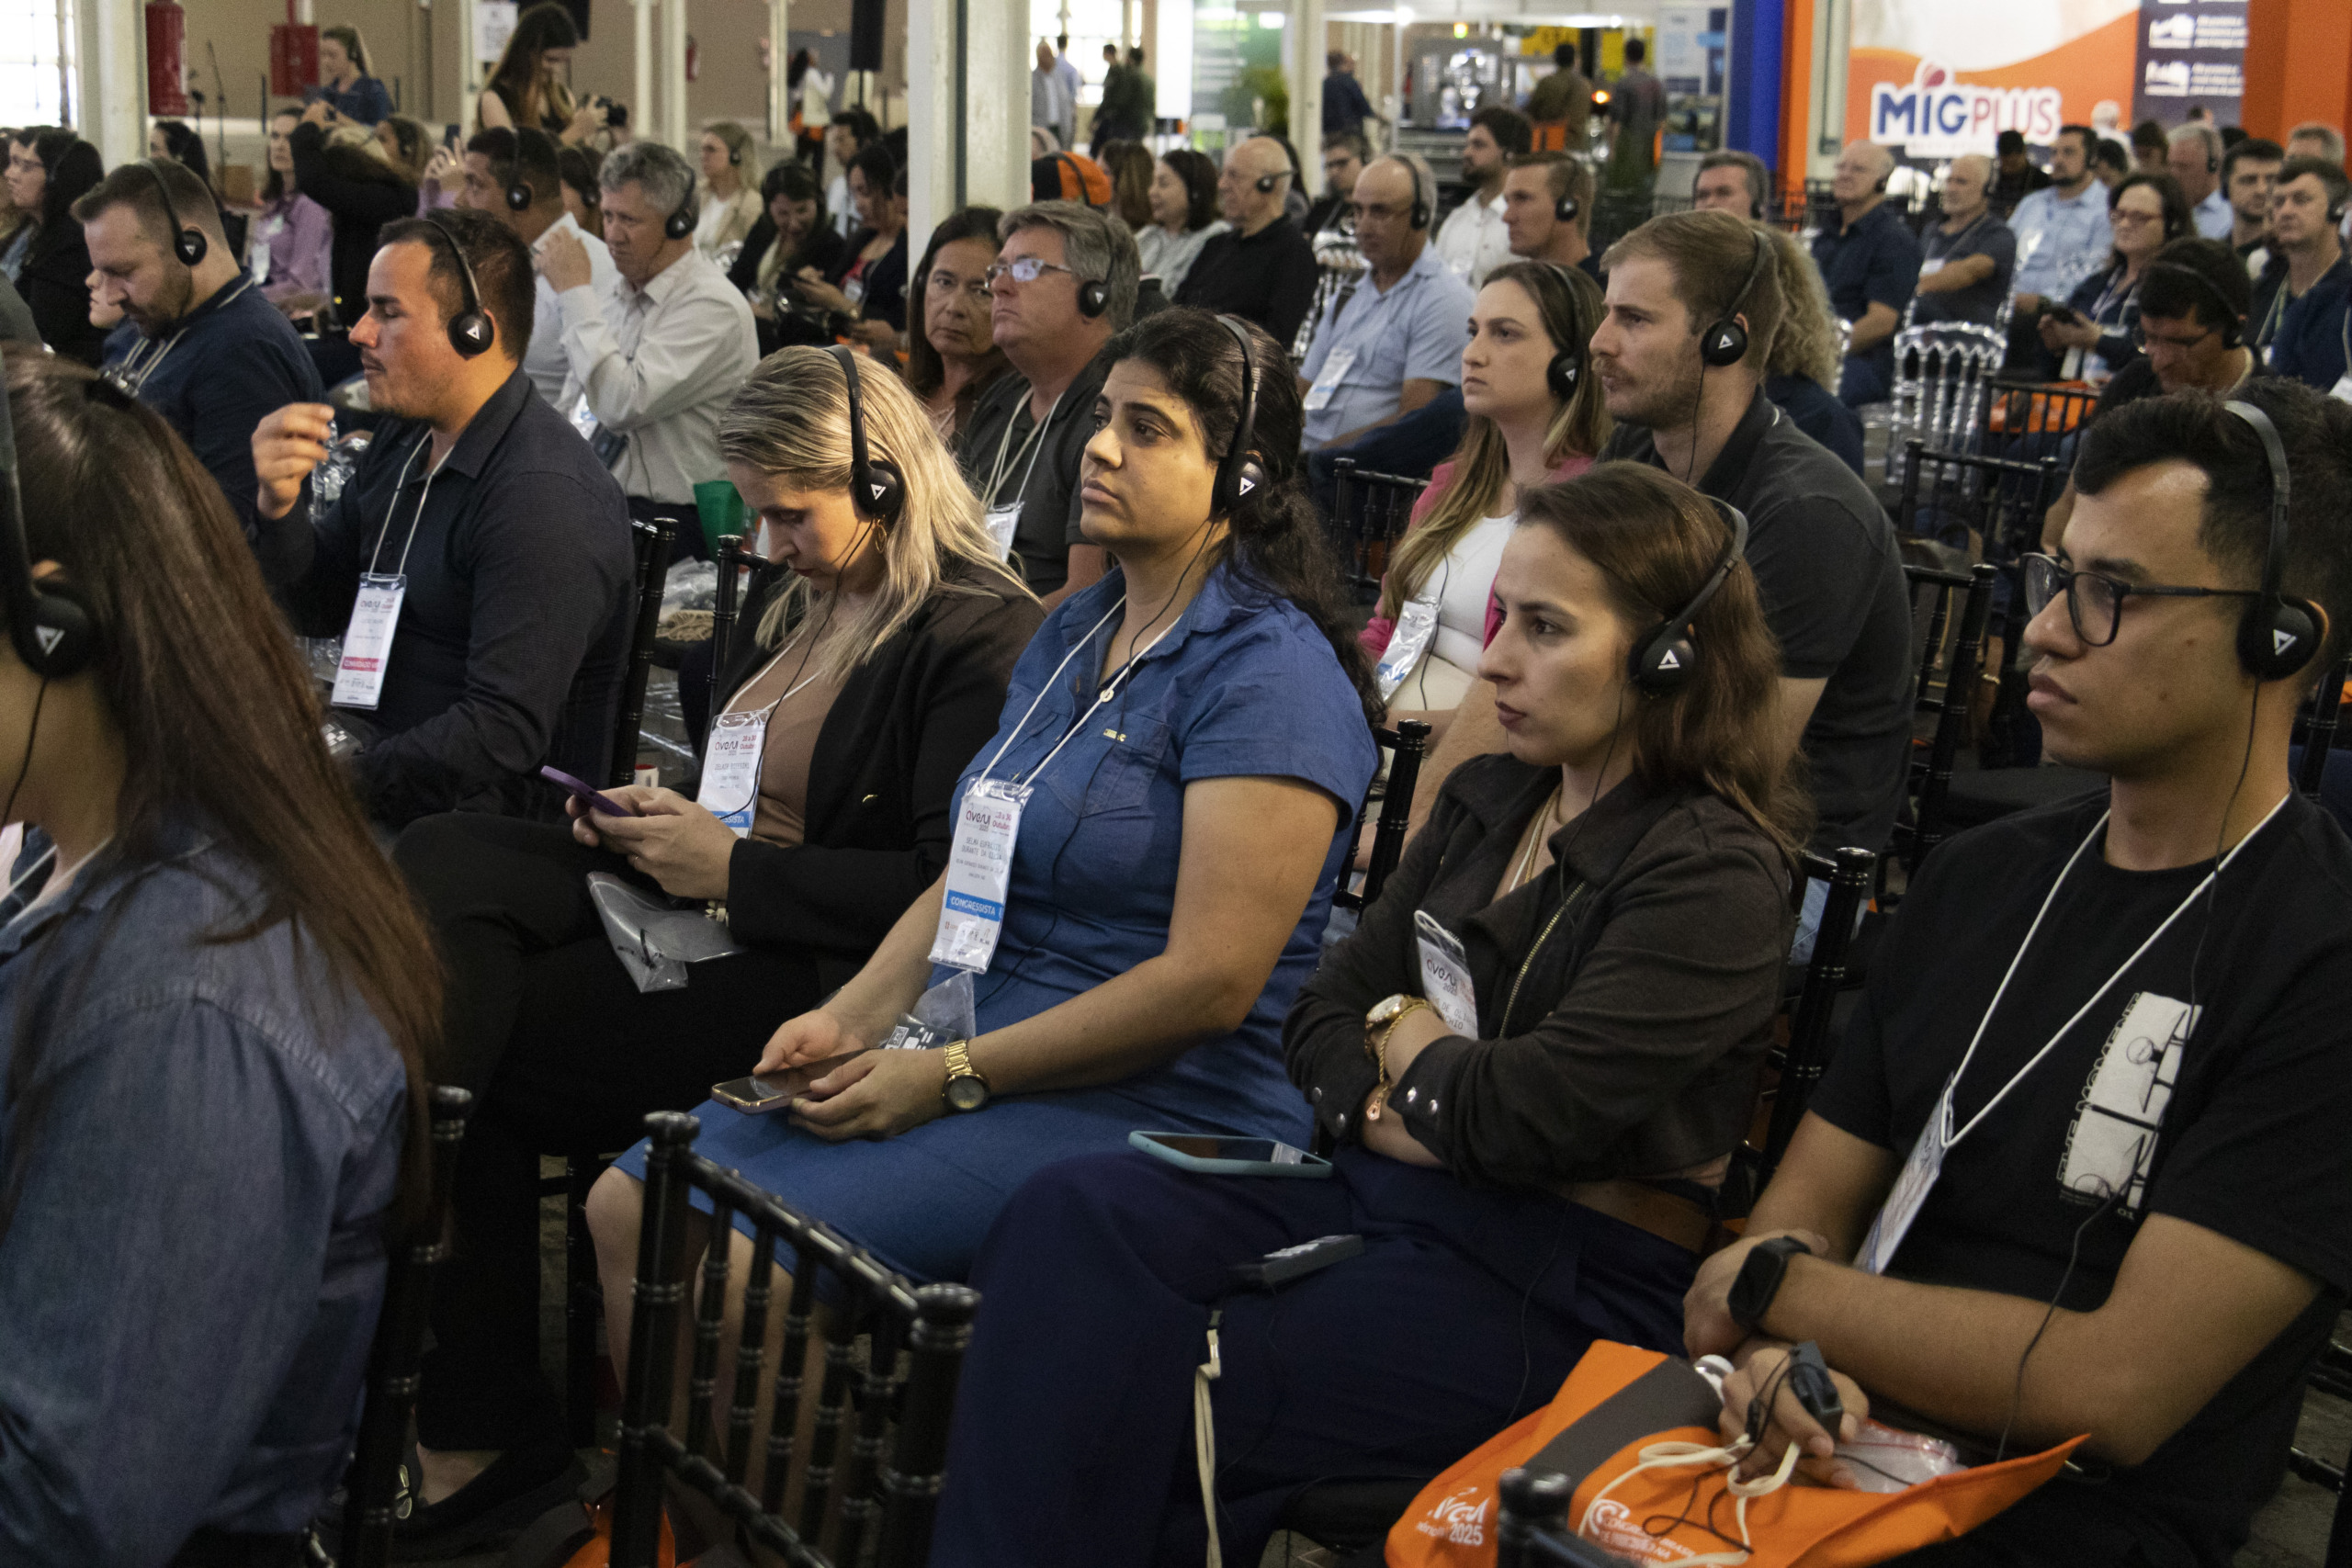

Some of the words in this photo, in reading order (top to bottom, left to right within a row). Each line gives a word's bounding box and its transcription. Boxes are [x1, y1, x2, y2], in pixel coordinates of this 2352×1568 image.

[1878, 93, 2052, 136] MIGPLUS
[951, 897, 996, 916] CONGRESSISTA
[1450, 1522, 1484, 1546] 2025
